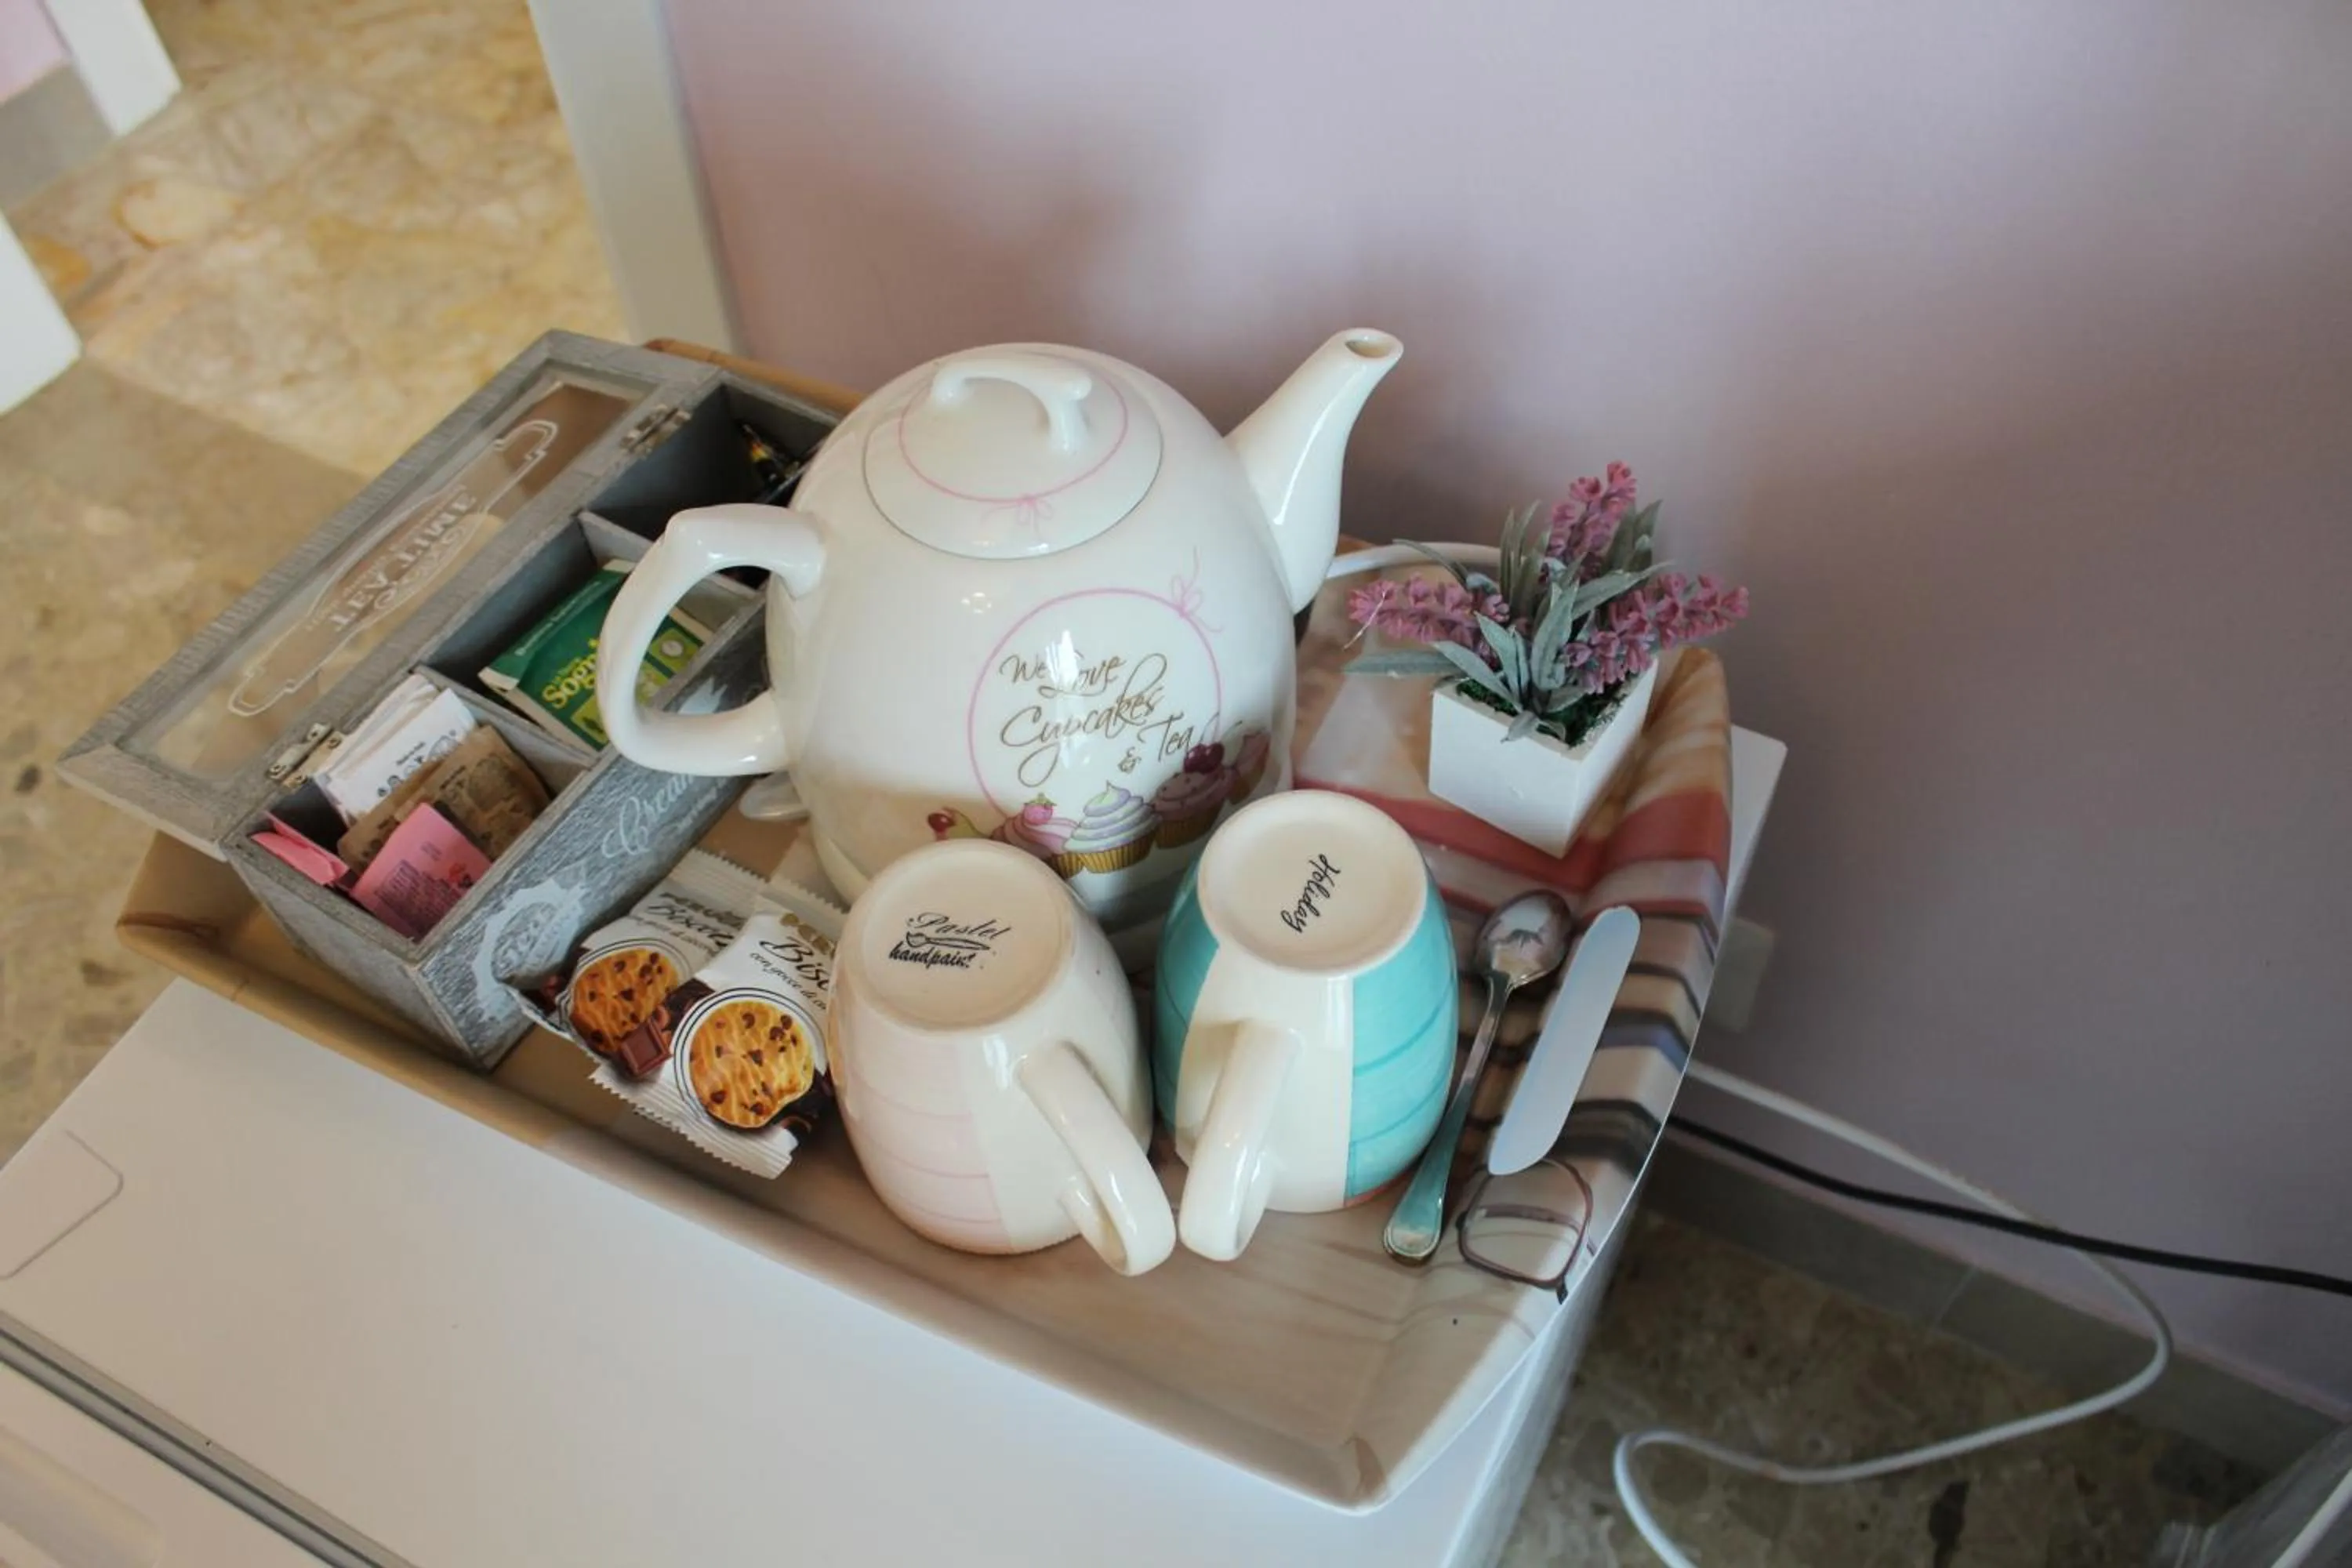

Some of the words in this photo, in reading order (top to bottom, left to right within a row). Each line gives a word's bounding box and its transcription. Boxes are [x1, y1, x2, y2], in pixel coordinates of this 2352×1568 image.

[542, 637, 599, 709] Sogn
[999, 654, 1047, 684] We
[1000, 652, 1167, 787] Cupcakes
[1136, 711, 1194, 763] Tea
[1280, 853, 1341, 933] Holiday
[906, 912, 1011, 940] Pastel
